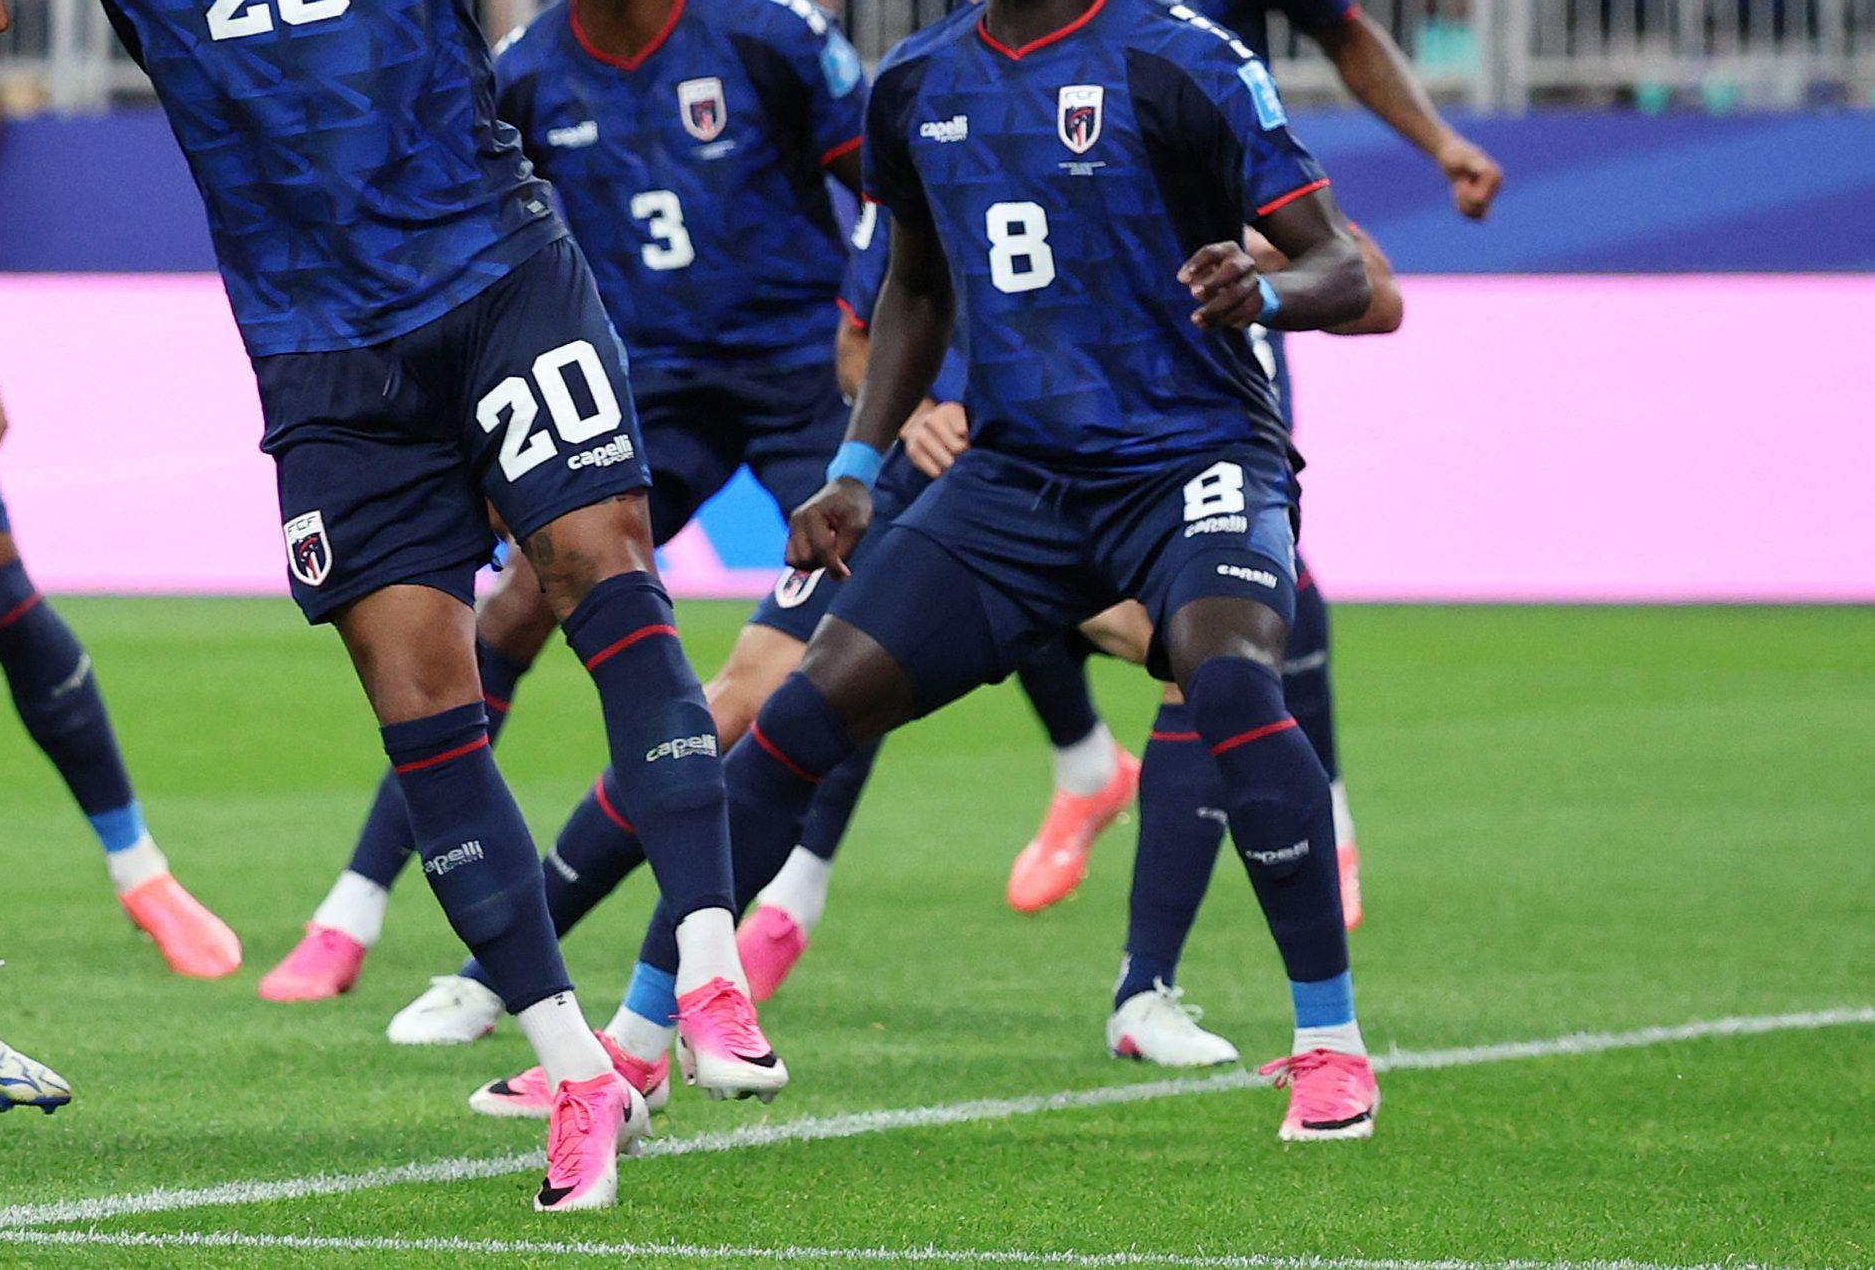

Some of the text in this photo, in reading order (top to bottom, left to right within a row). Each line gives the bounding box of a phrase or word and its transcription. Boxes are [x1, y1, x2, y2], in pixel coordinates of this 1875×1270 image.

[631, 189, 696, 271] 3
[986, 201, 1056, 294] 8
[475, 339, 623, 483] 20
[567, 434, 634, 470] capelli
[1183, 460, 1245, 522] 8
[287, 516, 317, 536] FCF
[646, 733, 717, 762] capelli
[425, 840, 485, 875] apelli
